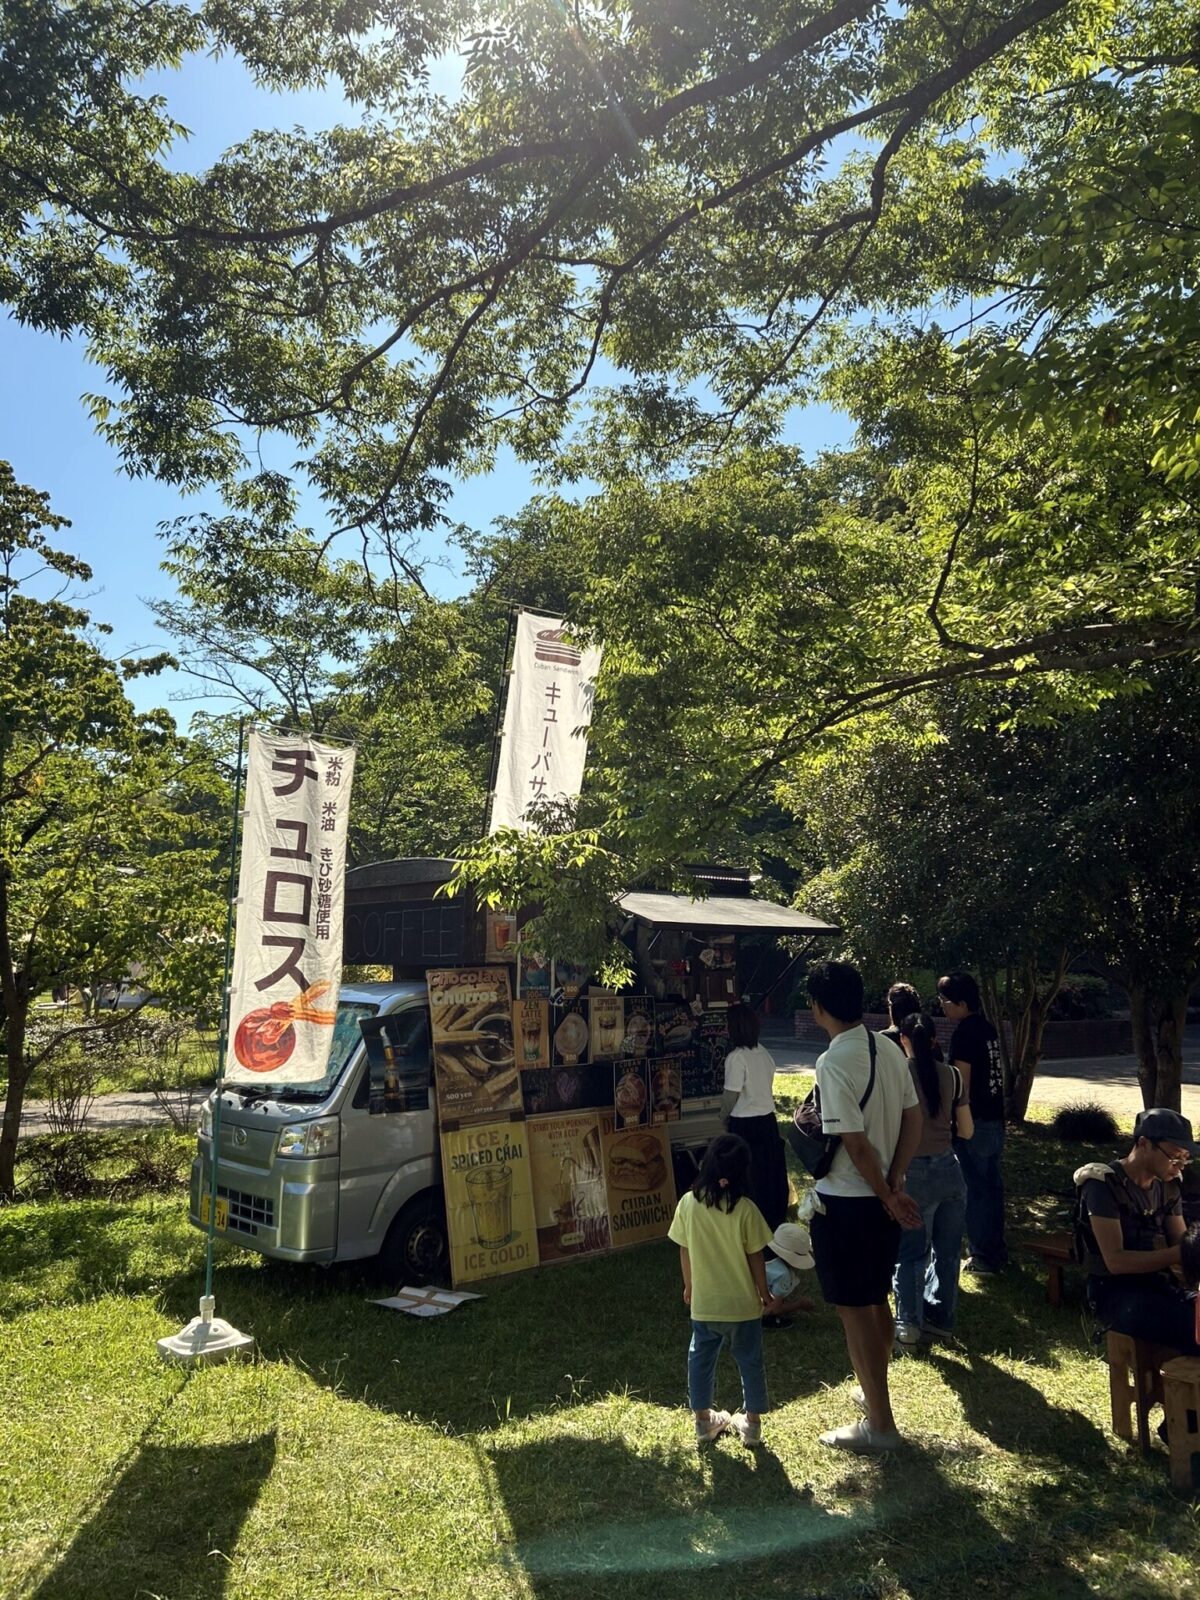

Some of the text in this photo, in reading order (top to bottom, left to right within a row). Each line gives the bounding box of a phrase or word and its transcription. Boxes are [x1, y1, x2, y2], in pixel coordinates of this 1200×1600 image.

[315, 756, 344, 941] 米粉 米油 きび砂糖使用
[254, 748, 320, 993] チュロス
[345, 905, 462, 961] COFFEE
[427, 970, 507, 988] Chocolate
[432, 990, 498, 1006] Churros
[523, 1000, 539, 1010] ZEN
[520, 1009, 542, 1019] LATTE
[467, 1130, 500, 1150] ICE
[451, 1143, 522, 1170] SPICED CHAI
[621, 1193, 661, 1212] CUBAN
[612, 1204, 673, 1232] SANDWICH!
[464, 1243, 530, 1271] ICE COLD!
